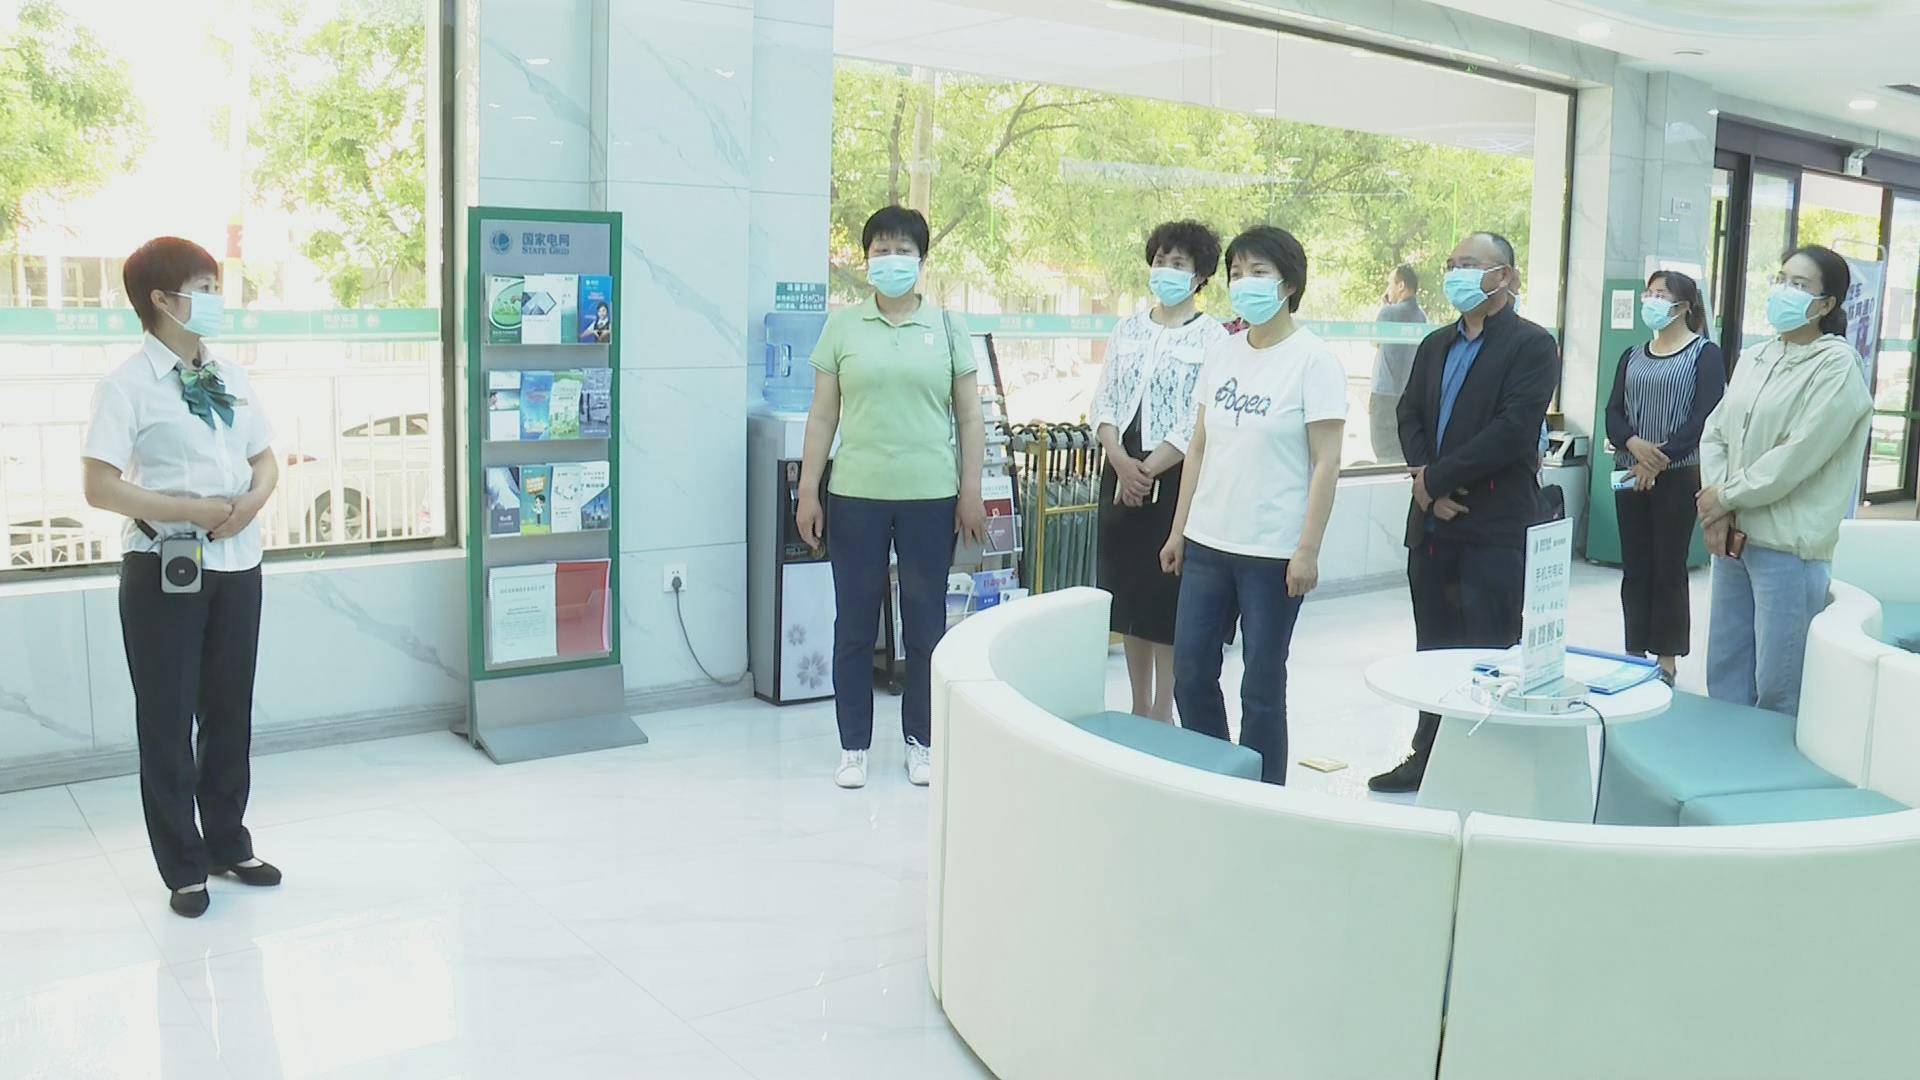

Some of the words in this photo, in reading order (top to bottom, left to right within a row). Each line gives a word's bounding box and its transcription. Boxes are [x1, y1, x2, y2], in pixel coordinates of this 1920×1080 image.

[522, 232, 570, 247] 国家电网
[522, 247, 547, 255] STATE
